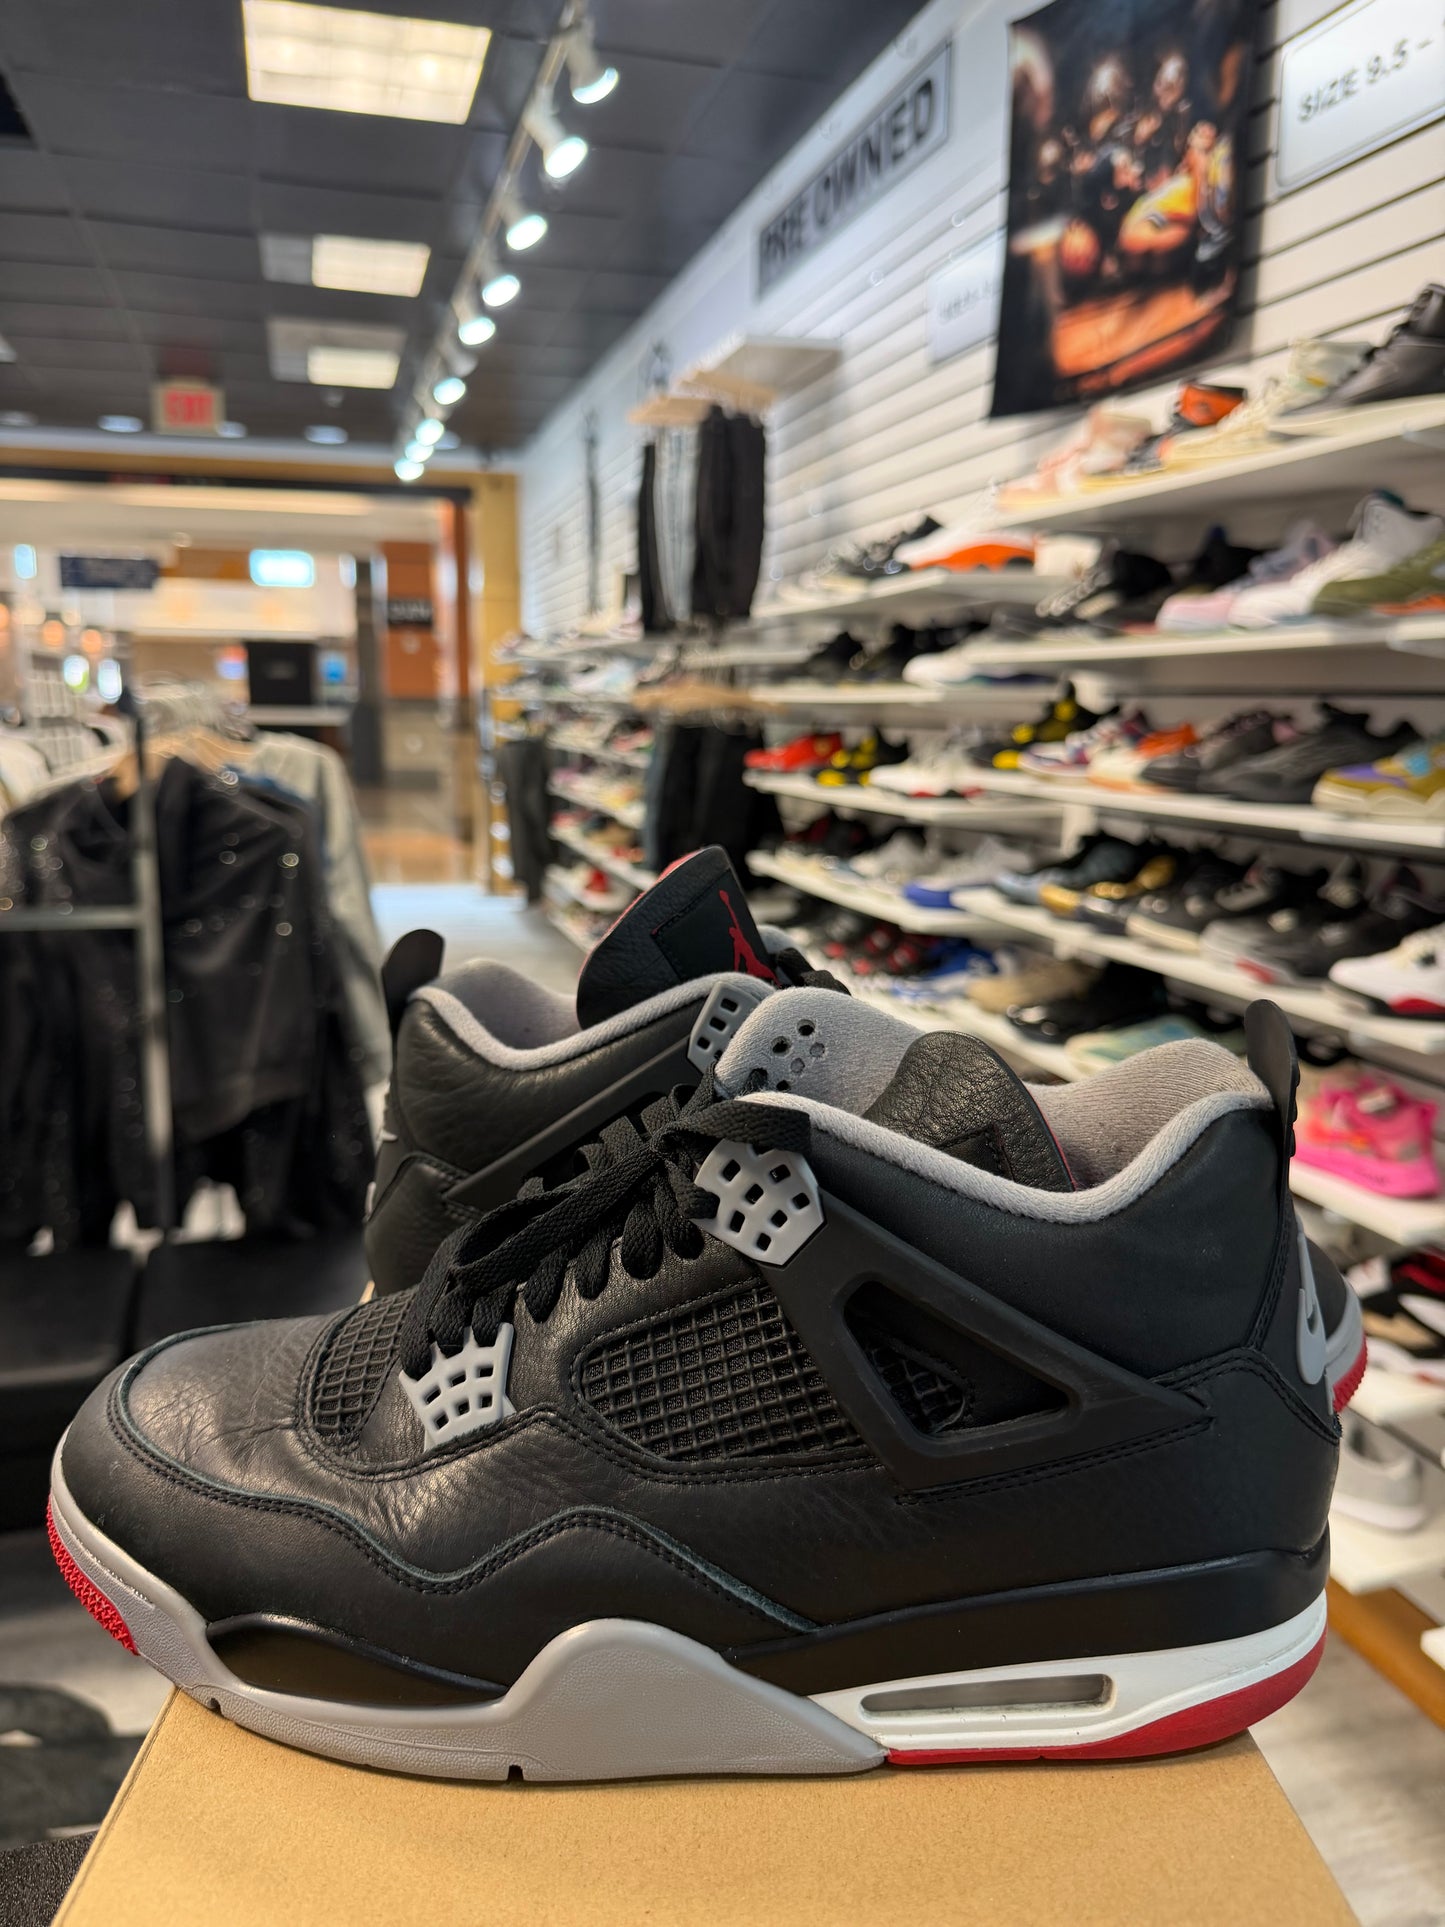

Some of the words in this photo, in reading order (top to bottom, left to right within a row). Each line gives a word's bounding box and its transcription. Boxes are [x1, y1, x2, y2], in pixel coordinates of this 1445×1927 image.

[1298, 67, 1359, 122] SIZE
[1366, 38, 1408, 84] 9.5
[761, 195, 808, 283] PRE
[810, 77, 935, 228] OWNED
